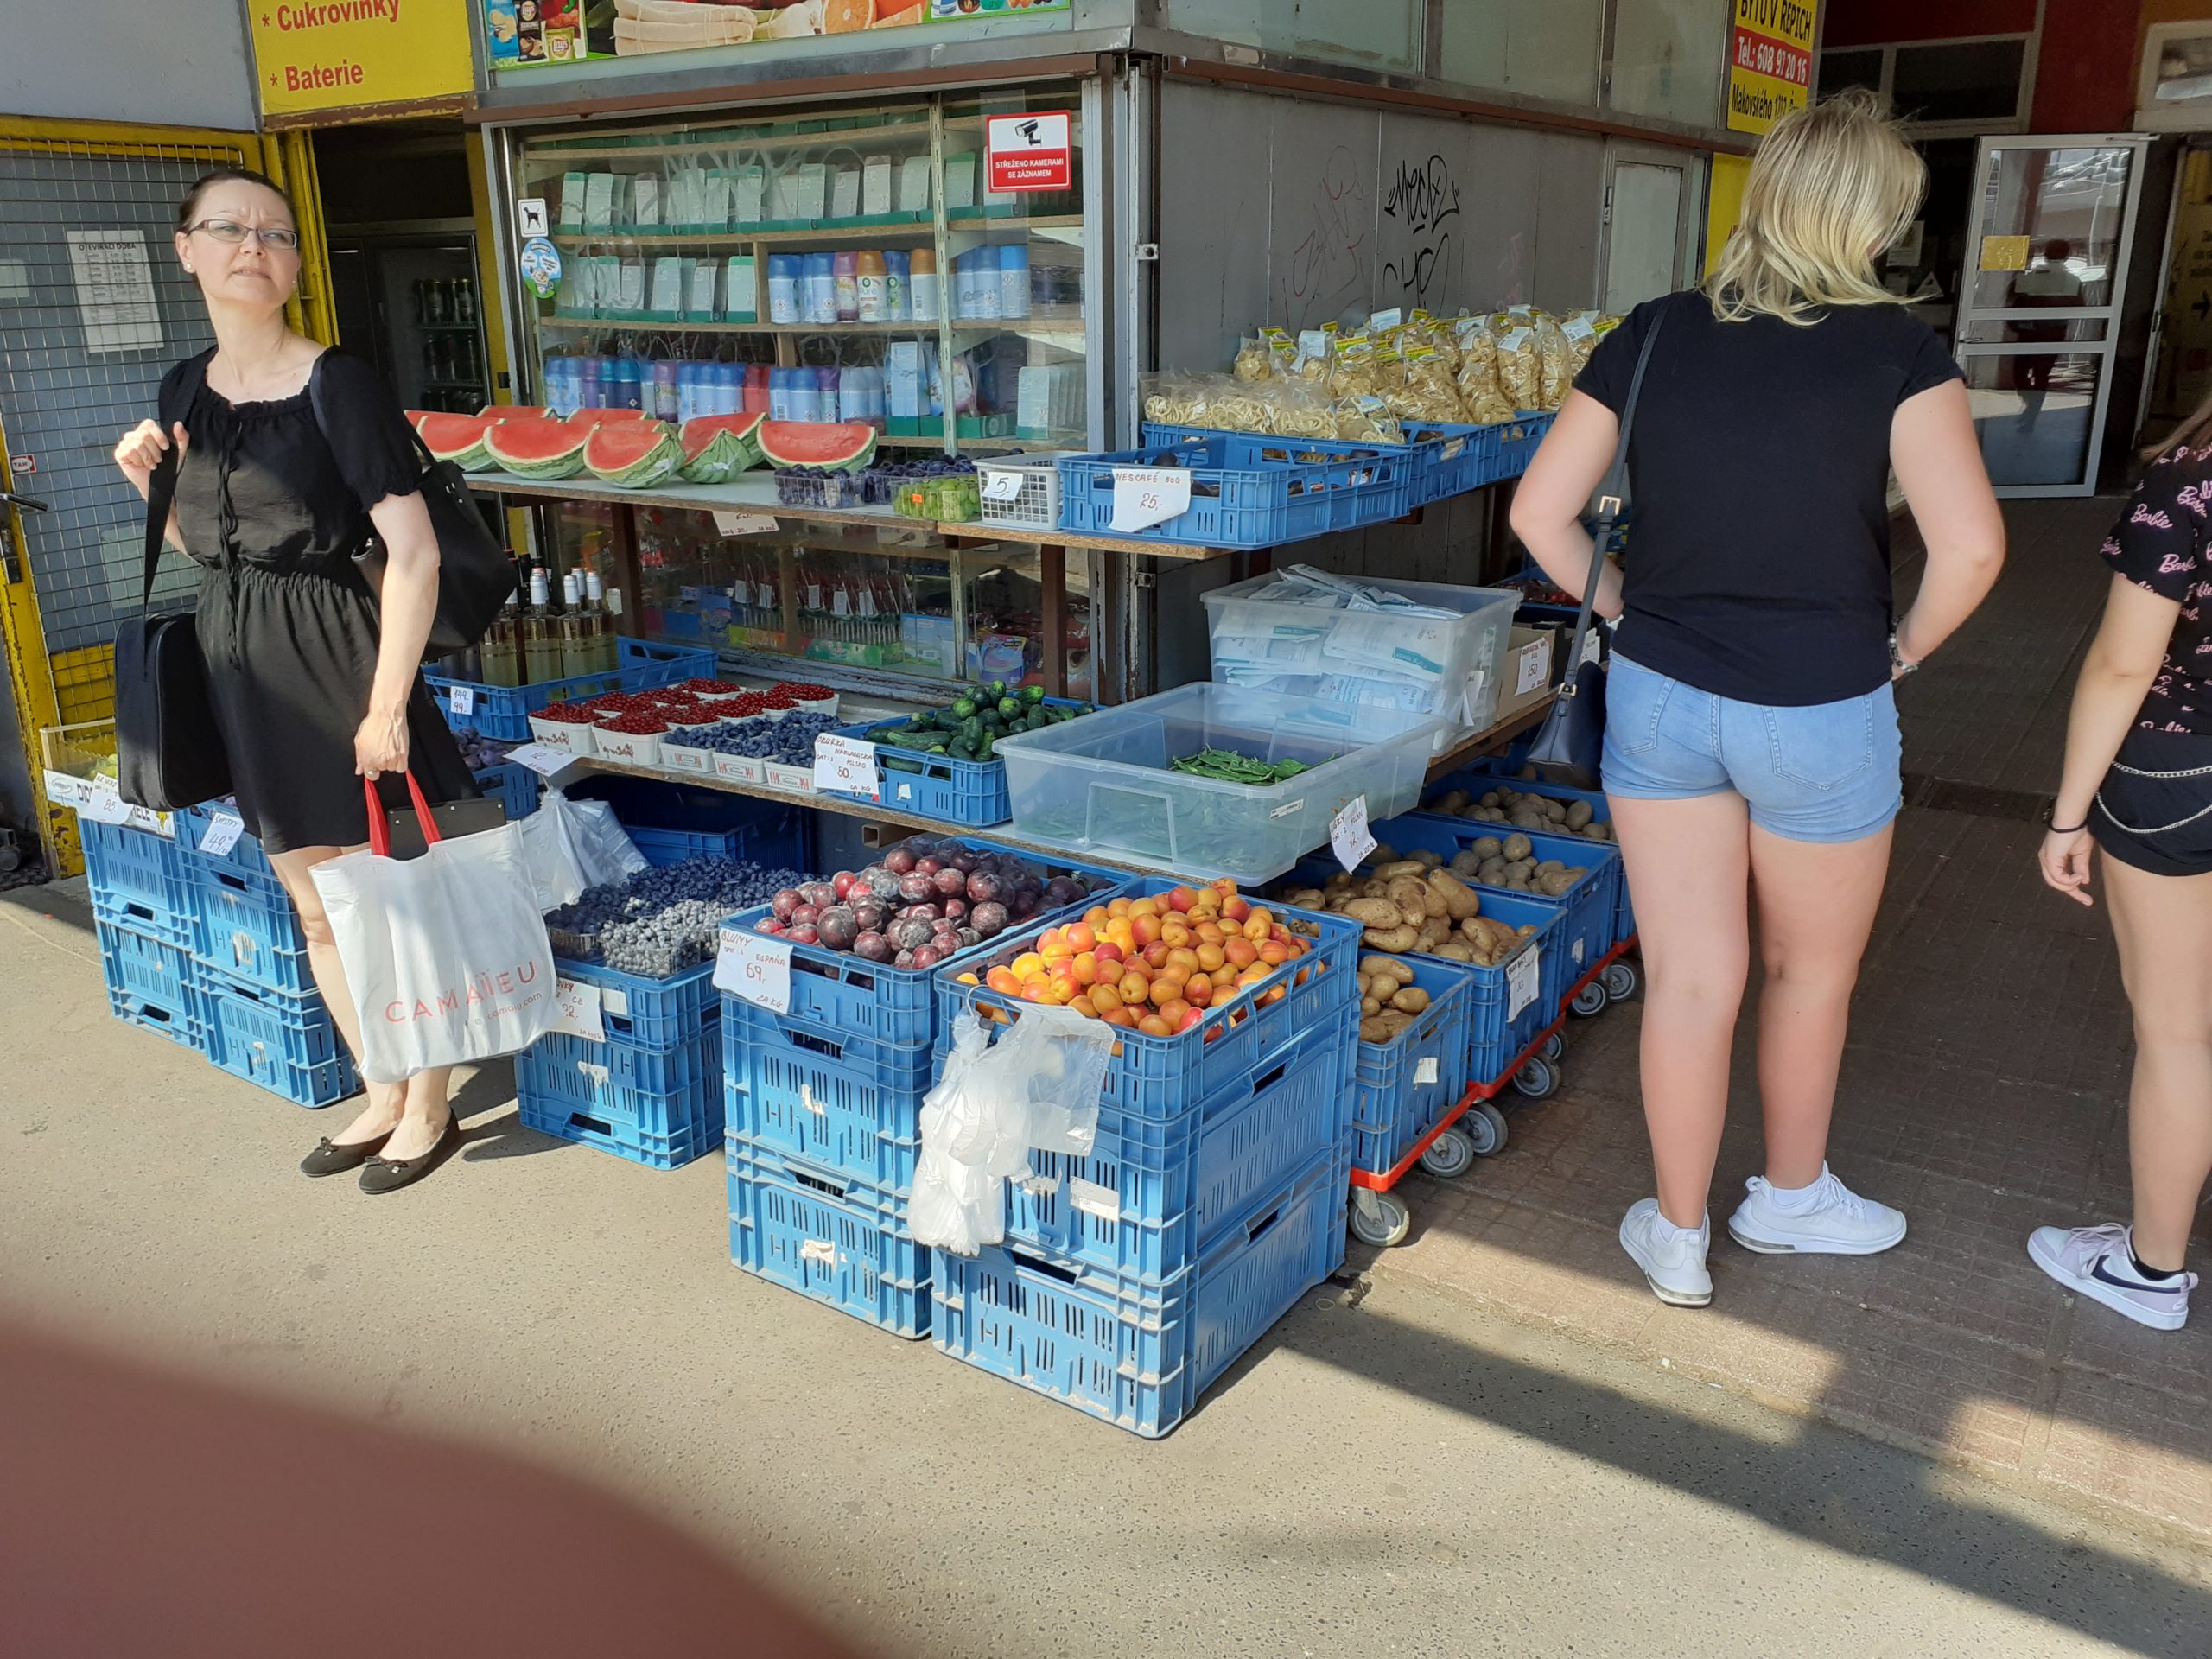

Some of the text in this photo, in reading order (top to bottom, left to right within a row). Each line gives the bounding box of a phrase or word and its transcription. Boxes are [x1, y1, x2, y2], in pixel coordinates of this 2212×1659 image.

[277, 0, 400, 31] Cukrovinky
[1757, 43, 1774, 73] 608
[1776, 48, 1786, 76] 97
[1785, 53, 1796, 80] 20
[1797, 57, 1807, 84] 16
[285, 60, 364, 91] Baterie
[1731, 83, 1773, 120] Makovského
[995, 159, 1028, 168] STŘEŽENO
[1017, 169, 1052, 178] ZÁZNAMEM
[1116, 471, 1160, 483] NESCAFÉ
[817, 736, 845, 747] OKURKA
[721, 931, 753, 946] BLUMY
[770, 997, 783, 1008] KG
